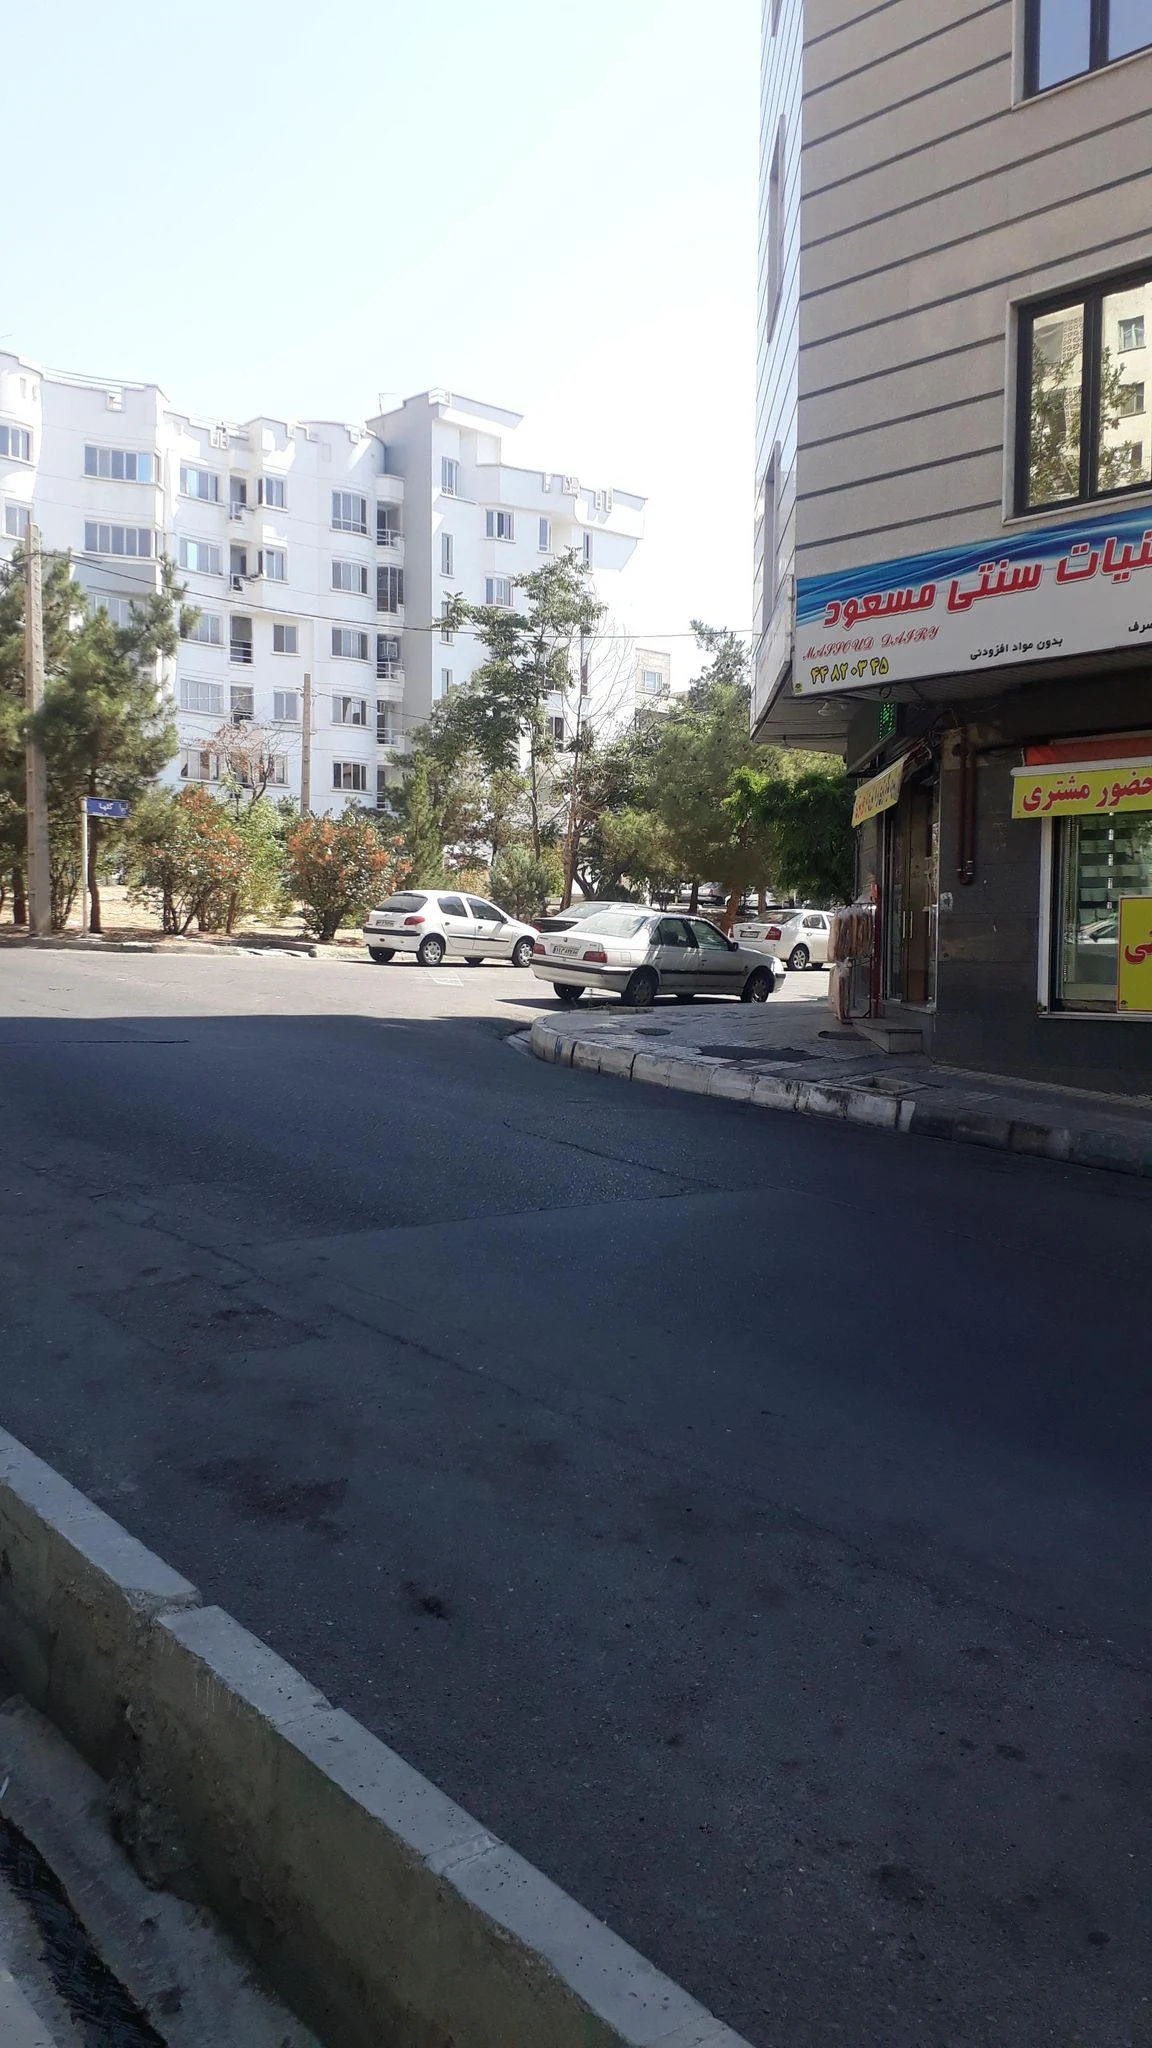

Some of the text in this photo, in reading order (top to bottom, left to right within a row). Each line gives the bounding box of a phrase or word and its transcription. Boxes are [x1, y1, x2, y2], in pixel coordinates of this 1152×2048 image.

[946, 559, 1043, 613] سنتی
[822, 582, 937, 631] مسعود
[881, 624, 941, 649] DAIRY
[970, 636, 1064, 661] بدون مواد افزودنی
[1022, 775, 1091, 812] مشتری
